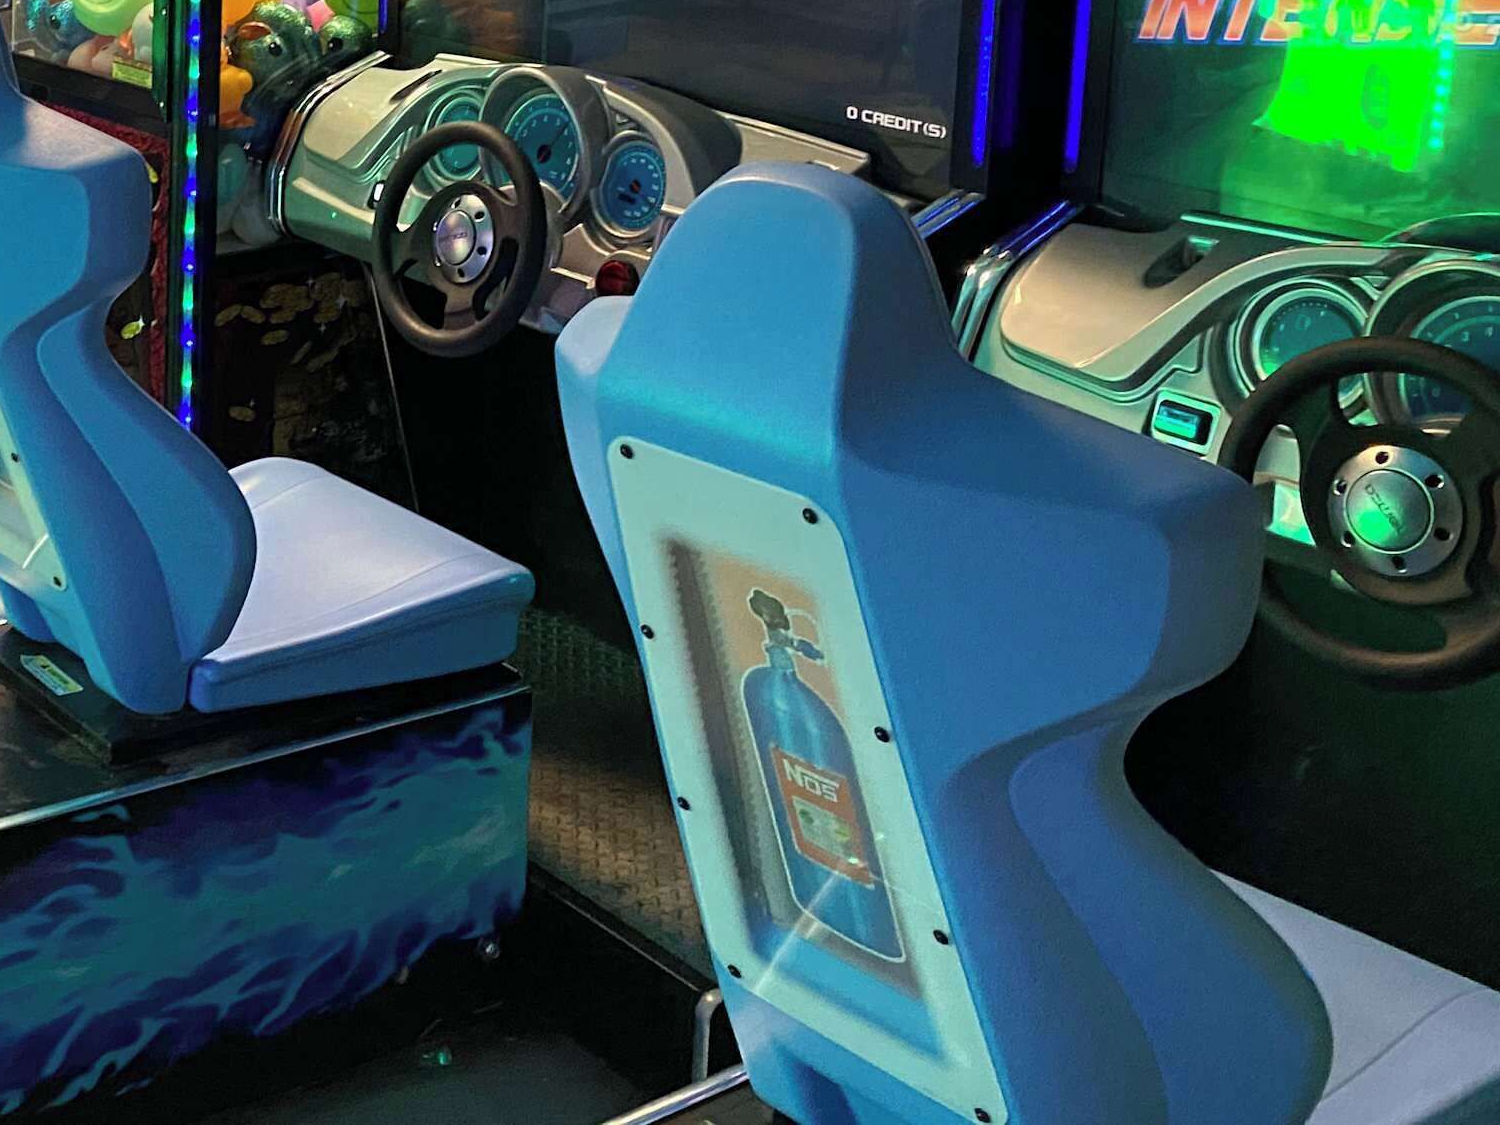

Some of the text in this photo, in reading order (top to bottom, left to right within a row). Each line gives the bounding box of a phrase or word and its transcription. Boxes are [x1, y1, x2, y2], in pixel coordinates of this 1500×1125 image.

[846, 105, 947, 138] 0 CREDIT(S)
[783, 758, 843, 803] NOS
